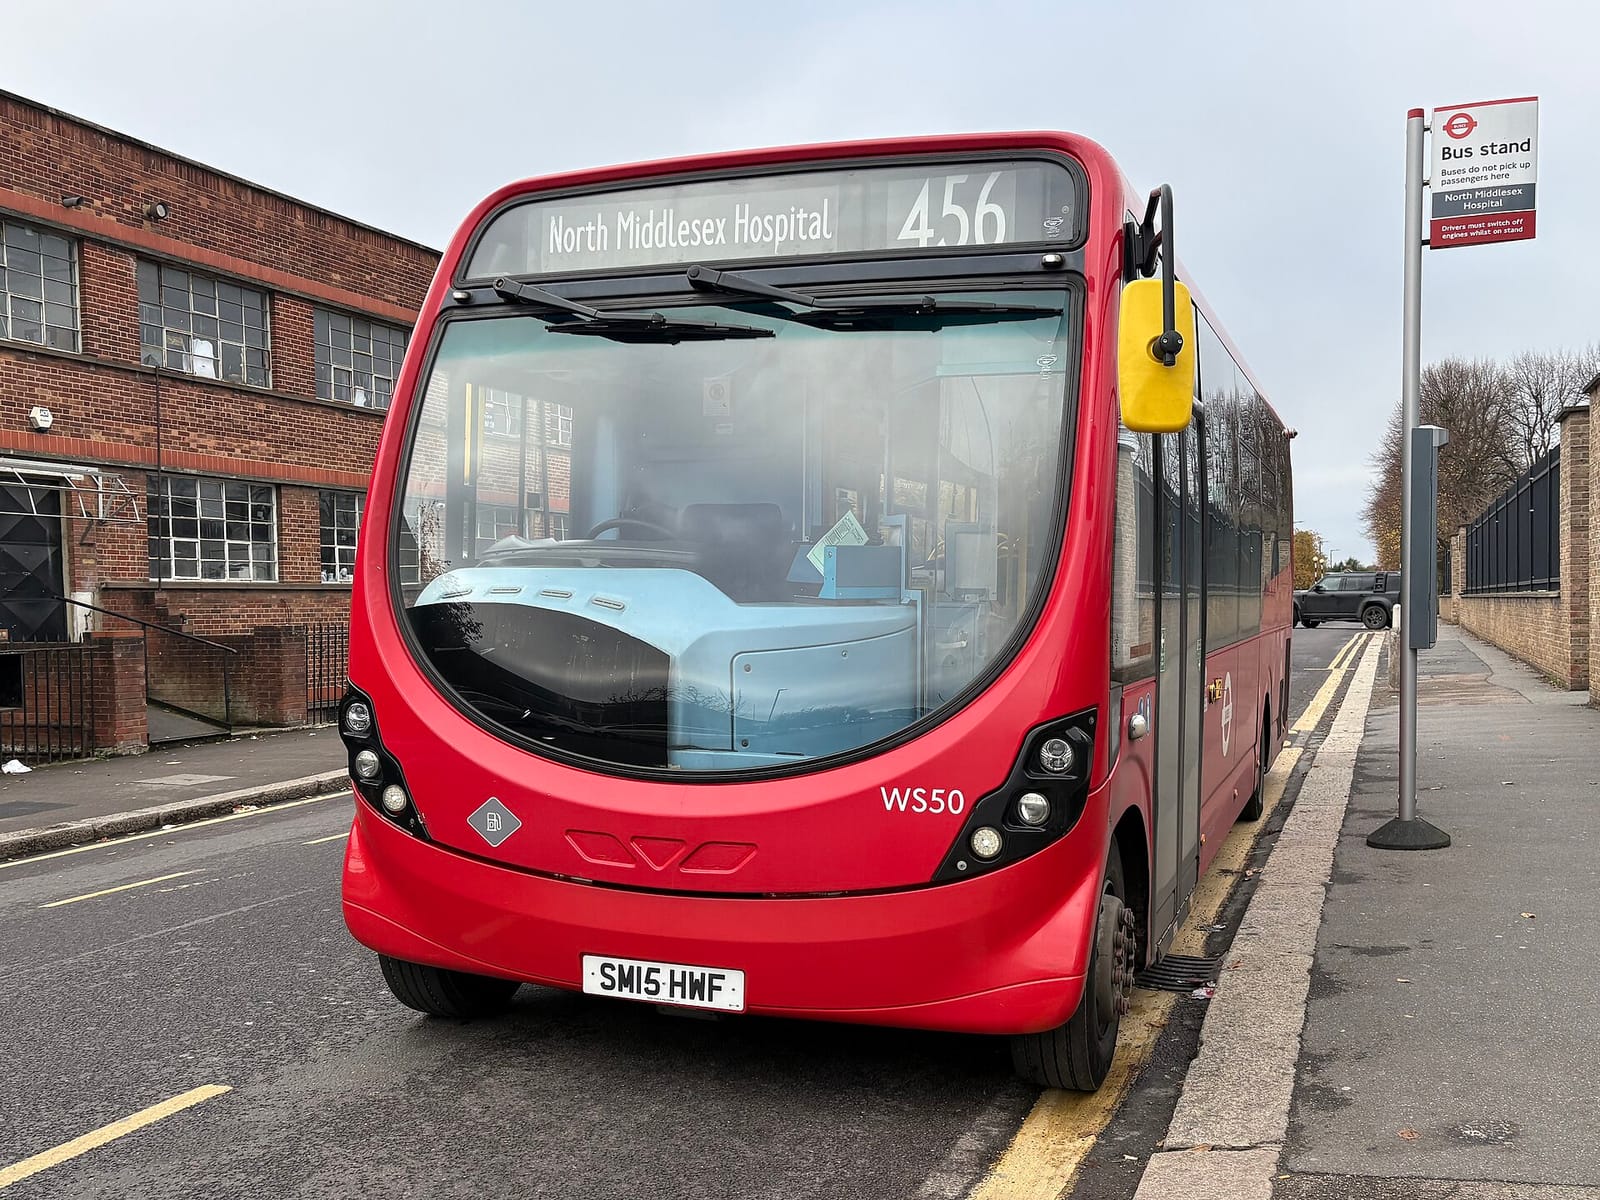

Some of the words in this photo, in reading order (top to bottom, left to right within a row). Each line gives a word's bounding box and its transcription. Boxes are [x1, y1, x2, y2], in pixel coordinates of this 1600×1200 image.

[1441, 146, 1473, 160] Bus
[1480, 138, 1531, 156] stand
[1441, 168, 1466, 177] Buses
[1468, 165, 1480, 173] do
[1482, 164, 1497, 172] not
[1499, 161, 1517, 174] pick
[1519, 161, 1531, 170] up
[1441, 173, 1489, 187] passengers
[1491, 171, 1510, 180] here
[1445, 192, 1472, 202] North
[1475, 187, 1523, 199] Middlesex
[897, 171, 1006, 248] 456
[1463, 199, 1503, 210] Hospital
[549, 213, 608, 254] North
[616, 207, 727, 250] Middlesex
[734, 198, 833, 255] Hospital
[1441, 224, 1466, 232] Drivers
[1487, 219, 1510, 228] switch
[1442, 231, 1468, 240] engines
[1470, 229, 1491, 237] whilst
[1503, 226, 1524, 234] stand
[880, 786, 964, 815] WS50
[600, 962, 661, 996] SM15
[669, 969, 726, 1002] HWF
